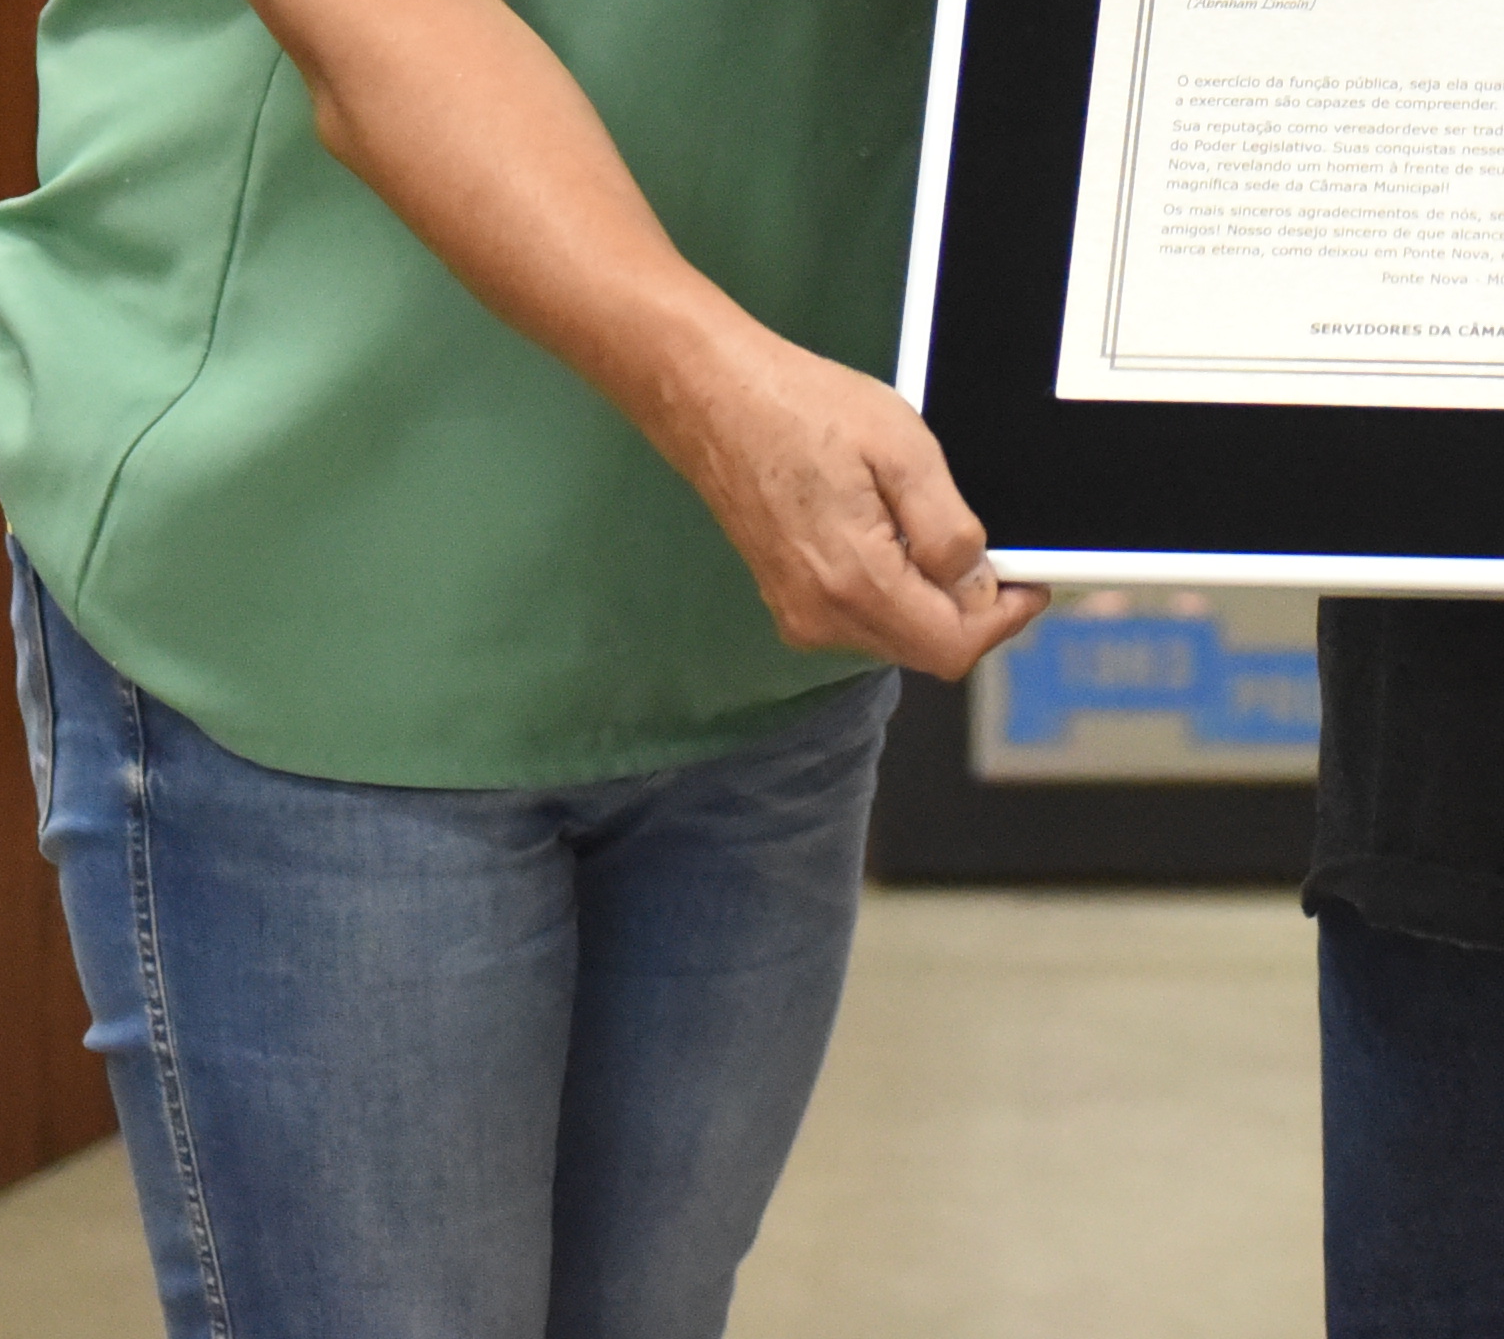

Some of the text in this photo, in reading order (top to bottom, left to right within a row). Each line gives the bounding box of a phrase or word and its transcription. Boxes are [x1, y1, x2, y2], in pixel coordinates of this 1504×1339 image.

[1176, 74, 1190, 88] O
[1193, 74, 1261, 89] exercício
[1265, 75, 1284, 89] da
[1289, 75, 1340, 92] função
[1344, 75, 1403, 92] pública,
[1409, 78, 1441, 94] seja
[1446, 77, 1469, 91] ela
[1174, 96, 1184, 107] a
[1189, 96, 1269, 108] exerceram
[1274, 94, 1301, 109] são
[1305, 97, 1366, 111] capazes
[1371, 95, 1391, 110] de
[1172, 118, 1201, 133] Sua
[1206, 119, 1282, 137] reputação
[1286, 122, 1328, 134] como
[1443, 125, 1468, 136] ser
[1169, 138, 1189, 152] do
[1193, 138, 1238, 153] Poder
[1332, 140, 1370, 155] Suas
[1374, 142, 1456, 158] conquistas
[1168, 157, 1210, 174] Nova,
[1216, 157, 1292, 173] revelando
[1296, 162, 1321, 173] um
[1326, 159, 1384, 174] homem
[1403, 160, 1450, 175] frente
[1454, 162, 1474, 176] de
[1165, 177, 1450, 197] magnífica sede da Câmara Municipal!
[1162, 202, 1183, 216] Os
[1188, 204, 1225, 217] mais
[1229, 204, 1292, 218] sinceros
[1297, 205, 1420, 221] agradecimentos
[1425, 207, 1445, 221] de
[1450, 207, 1482, 223] nós,
[1160, 223, 1221, 239] amigos!
[1226, 222, 1273, 237] Nosso
[1276, 223, 1328, 241] desejo
[1332, 226, 1388, 239] sincero
[1392, 226, 1412, 240] de
[1416, 229, 1446, 242] que
[1158, 243, 1206, 256] marca
[1211, 243, 1265, 259] eterna,
[1271, 245, 1313, 257] como
[1317, 244, 1369, 258] deixou
[1373, 247, 1398, 259] em
[1402, 245, 1446, 260] Ponte
[1451, 247, 1494, 263] Nova,
[1381, 270, 1425, 285] Ponte
[1430, 272, 1469, 286] Nova
[1310, 322, 1422, 336] SERVIDORES
[1428, 324, 1452, 336] DA
